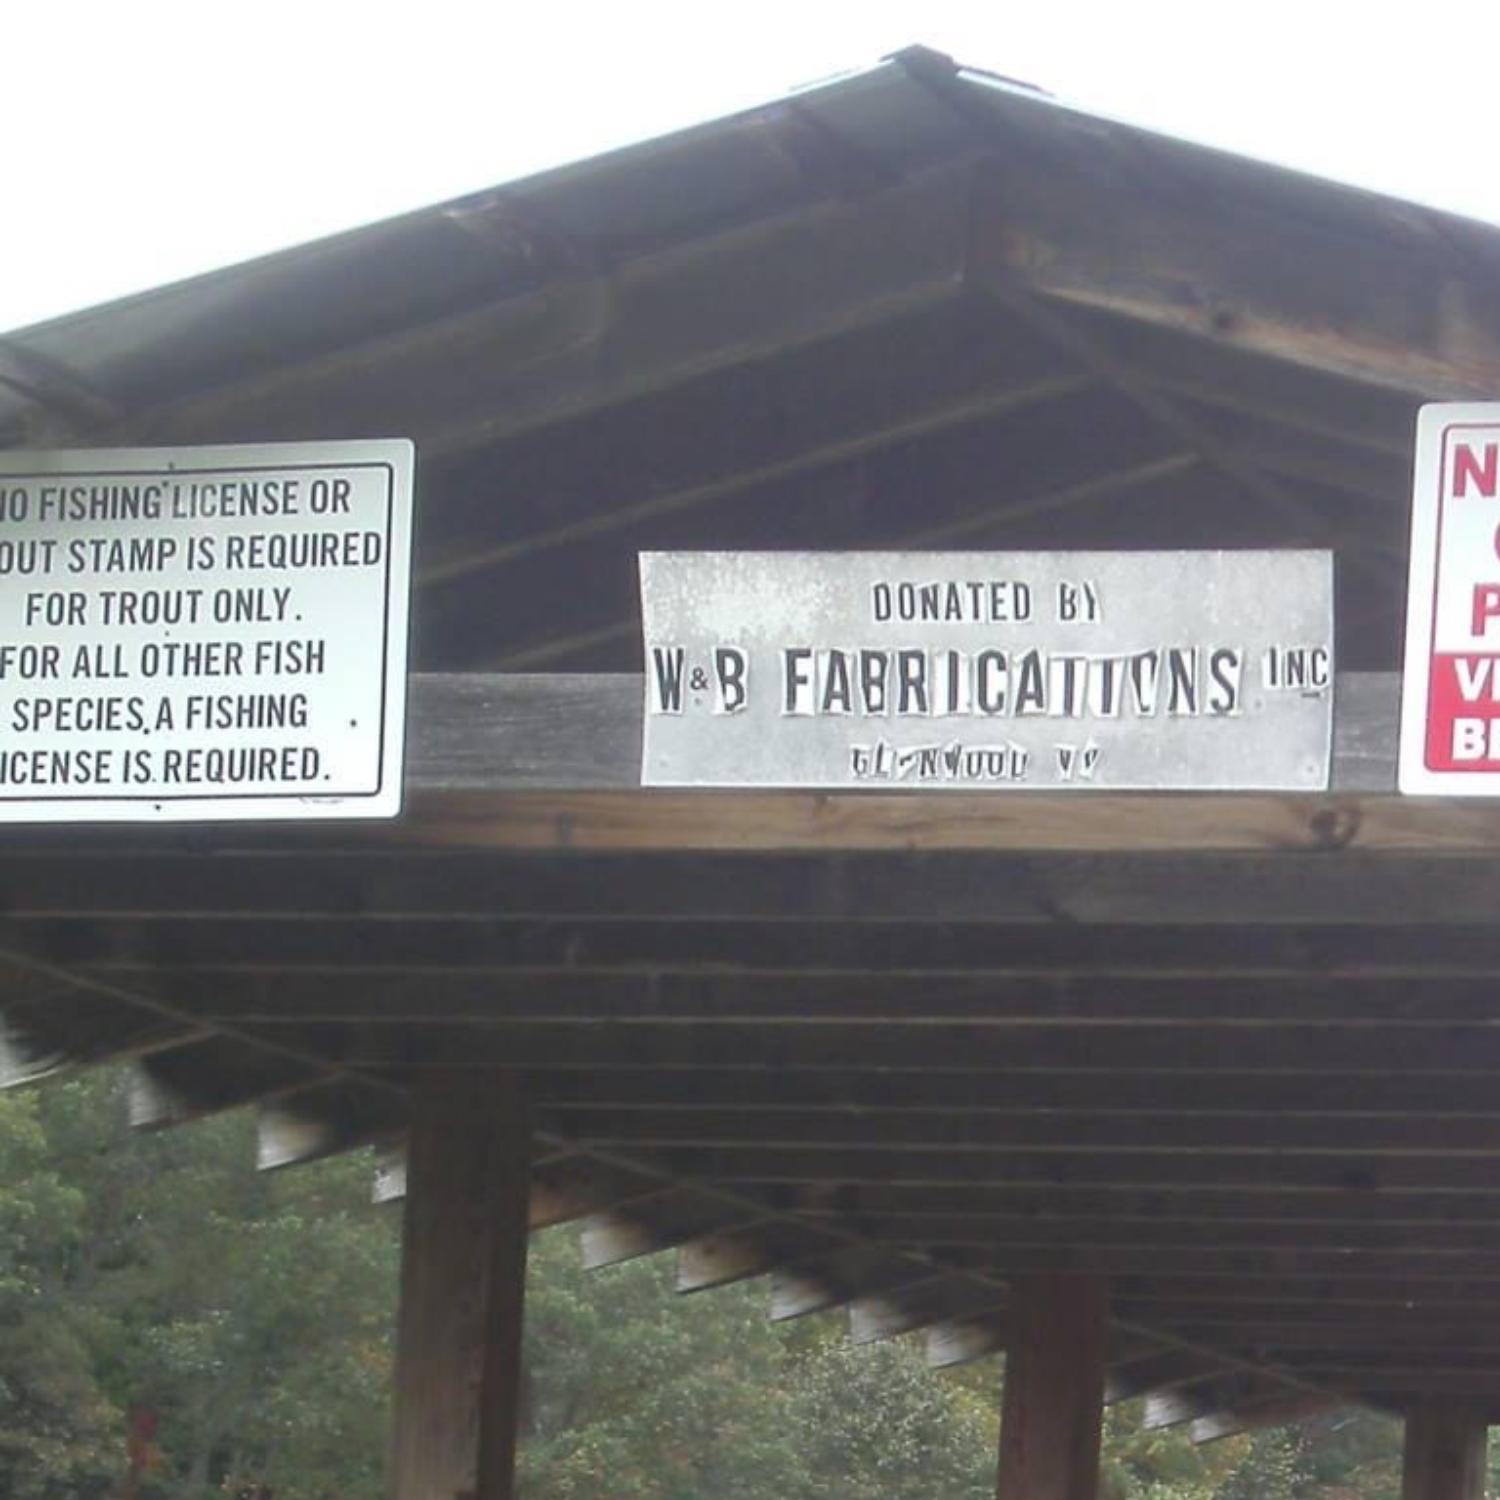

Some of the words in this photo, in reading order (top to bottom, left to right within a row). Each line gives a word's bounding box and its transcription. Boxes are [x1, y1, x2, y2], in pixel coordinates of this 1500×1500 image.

[39, 484, 161, 521] FISHING
[172, 481, 299, 519] LICENSE
[310, 479, 351, 514] OR
[67, 537, 177, 573] STAMP
[186, 536, 215, 571] IS
[226, 532, 382, 569] REQUIRED
[26, 592, 87, 626] FOR
[100, 590, 203, 625] TROUT
[213, 587, 302, 623] ONLY.
[874, 582, 1031, 622] DONATED
[0, 645, 60, 679] FOR
[72, 644, 129, 679] ALL
[140, 642, 243, 677] OTHER
[254, 640, 326, 675] FISH
[155, 696, 174, 731] A
[186, 694, 308, 730] FISHING
[0, 750, 113, 784] ICENSE
[122, 749, 152, 784] IS
[163, 747, 331, 783] REQUIRED.
